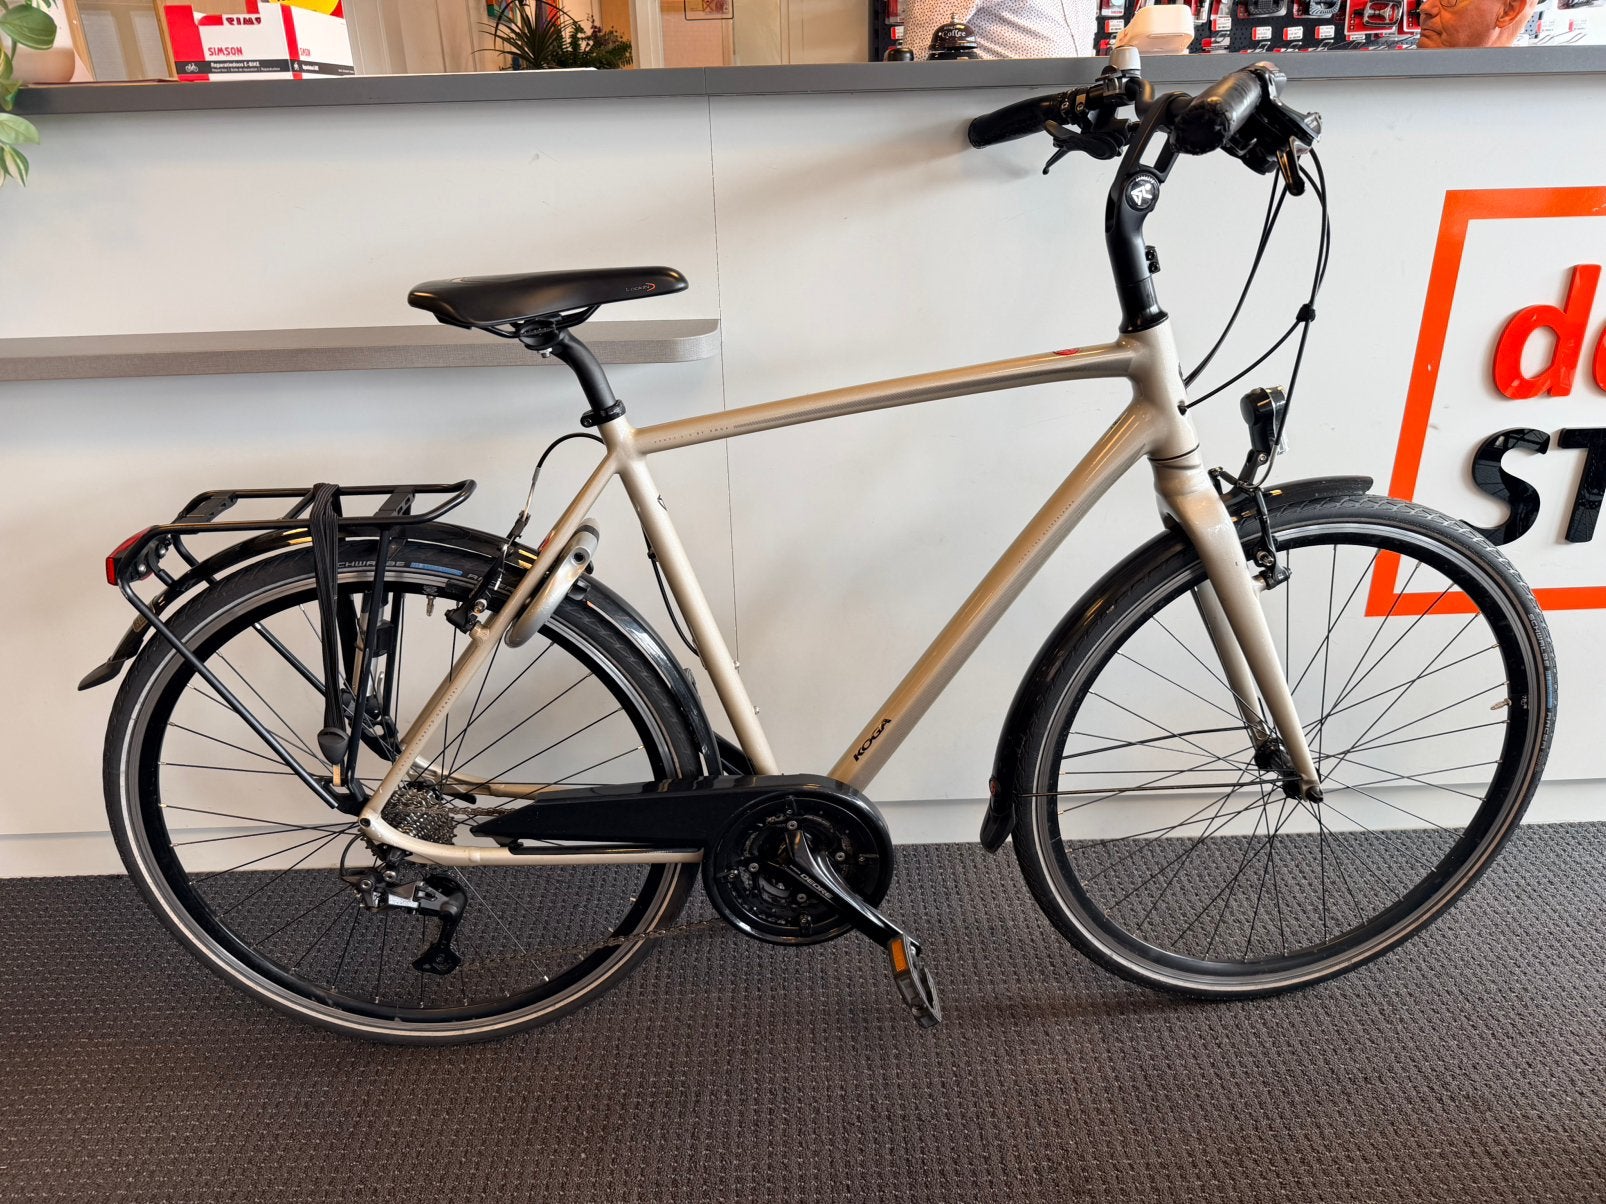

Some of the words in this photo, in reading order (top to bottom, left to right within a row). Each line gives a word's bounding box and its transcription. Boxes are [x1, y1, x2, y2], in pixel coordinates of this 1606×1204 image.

[207, 46, 243, 56] SIMSON
[337, 560, 406, 568] CHWABE
[1528, 613, 1550, 667] SCHWALBE
[853, 718, 892, 762] KOGA
[800, 873, 834, 899] DEORE
